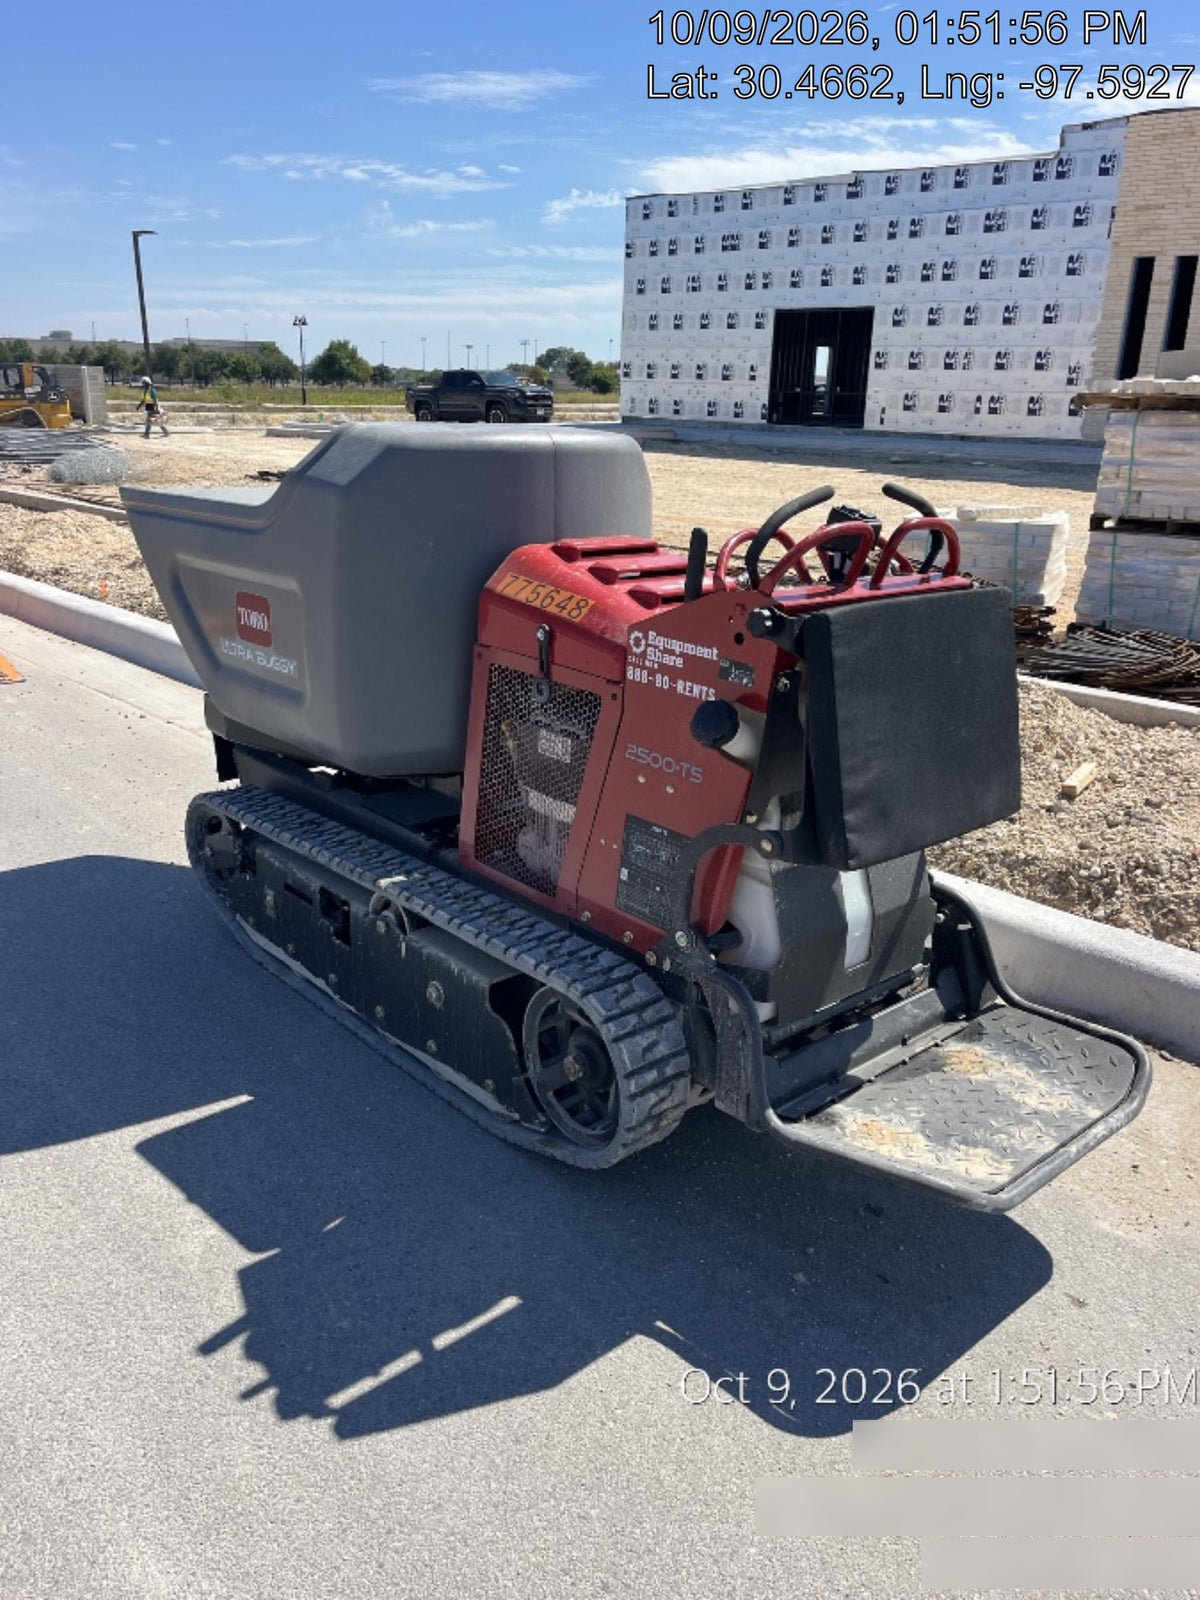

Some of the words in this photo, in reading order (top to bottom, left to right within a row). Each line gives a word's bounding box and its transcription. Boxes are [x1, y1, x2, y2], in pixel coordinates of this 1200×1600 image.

[500, 574, 589, 619] 775648
[237, 606, 269, 632] TORO
[646, 646, 684, 668] Share
[648, 630, 719, 660] Equipment
[256, 651, 297, 675] BUGGY
[627, 666, 716, 701] 888-80-RENTS
